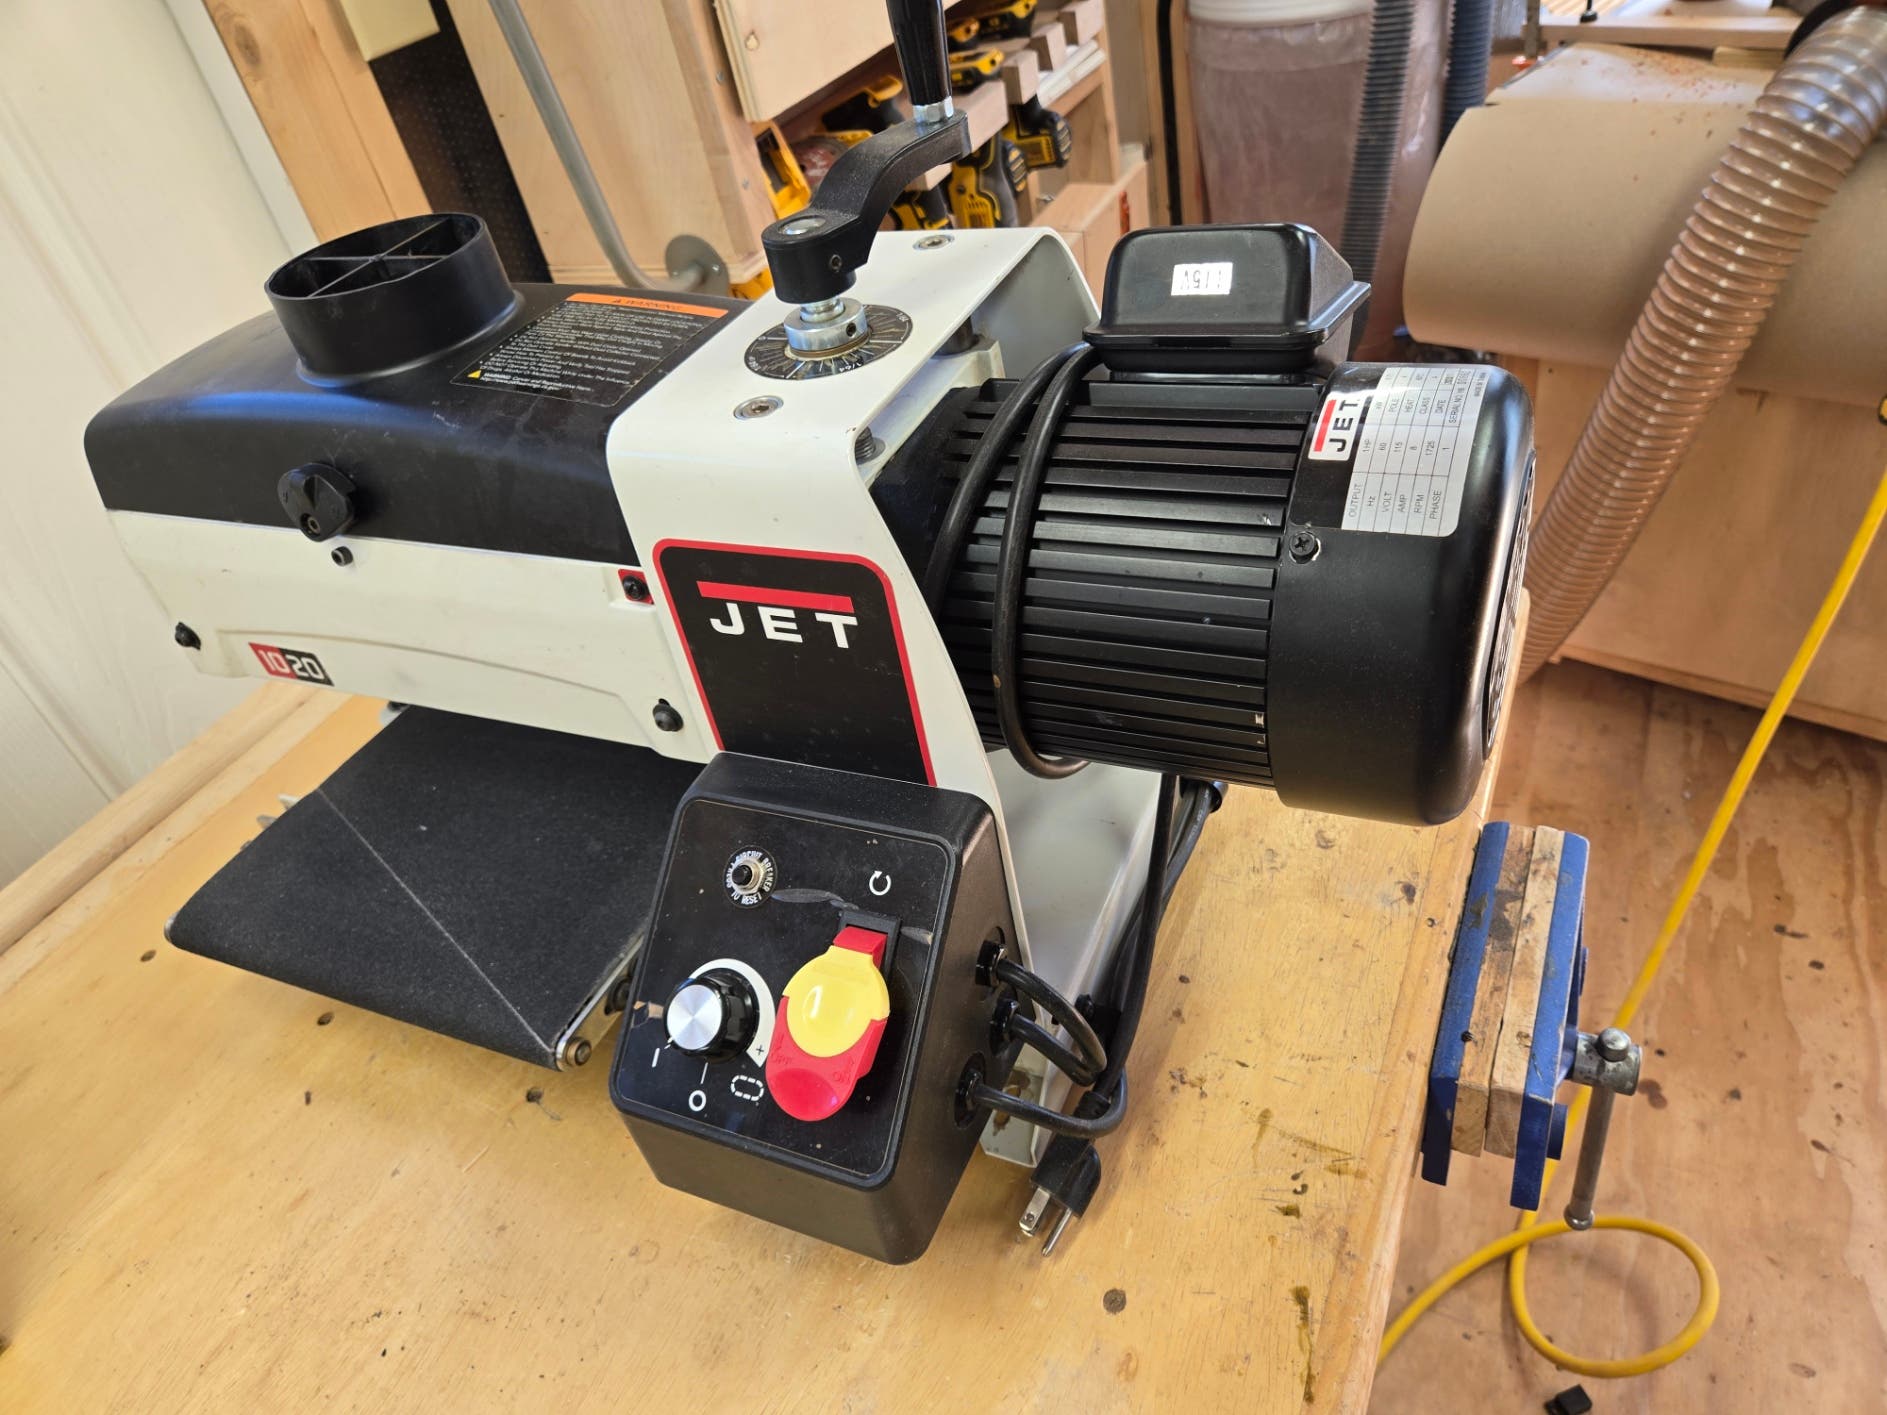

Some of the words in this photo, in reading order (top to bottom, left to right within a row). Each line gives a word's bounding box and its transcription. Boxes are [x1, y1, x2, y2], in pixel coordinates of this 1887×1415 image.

[1329, 399, 1359, 452] JET
[1348, 483, 1362, 518] OUTPUT
[1381, 491, 1393, 513] VOLT
[1397, 494, 1409, 513] AMP
[1413, 494, 1425, 514] RPM
[1429, 490, 1442, 520] PHASE
[710, 602, 858, 649] JET
